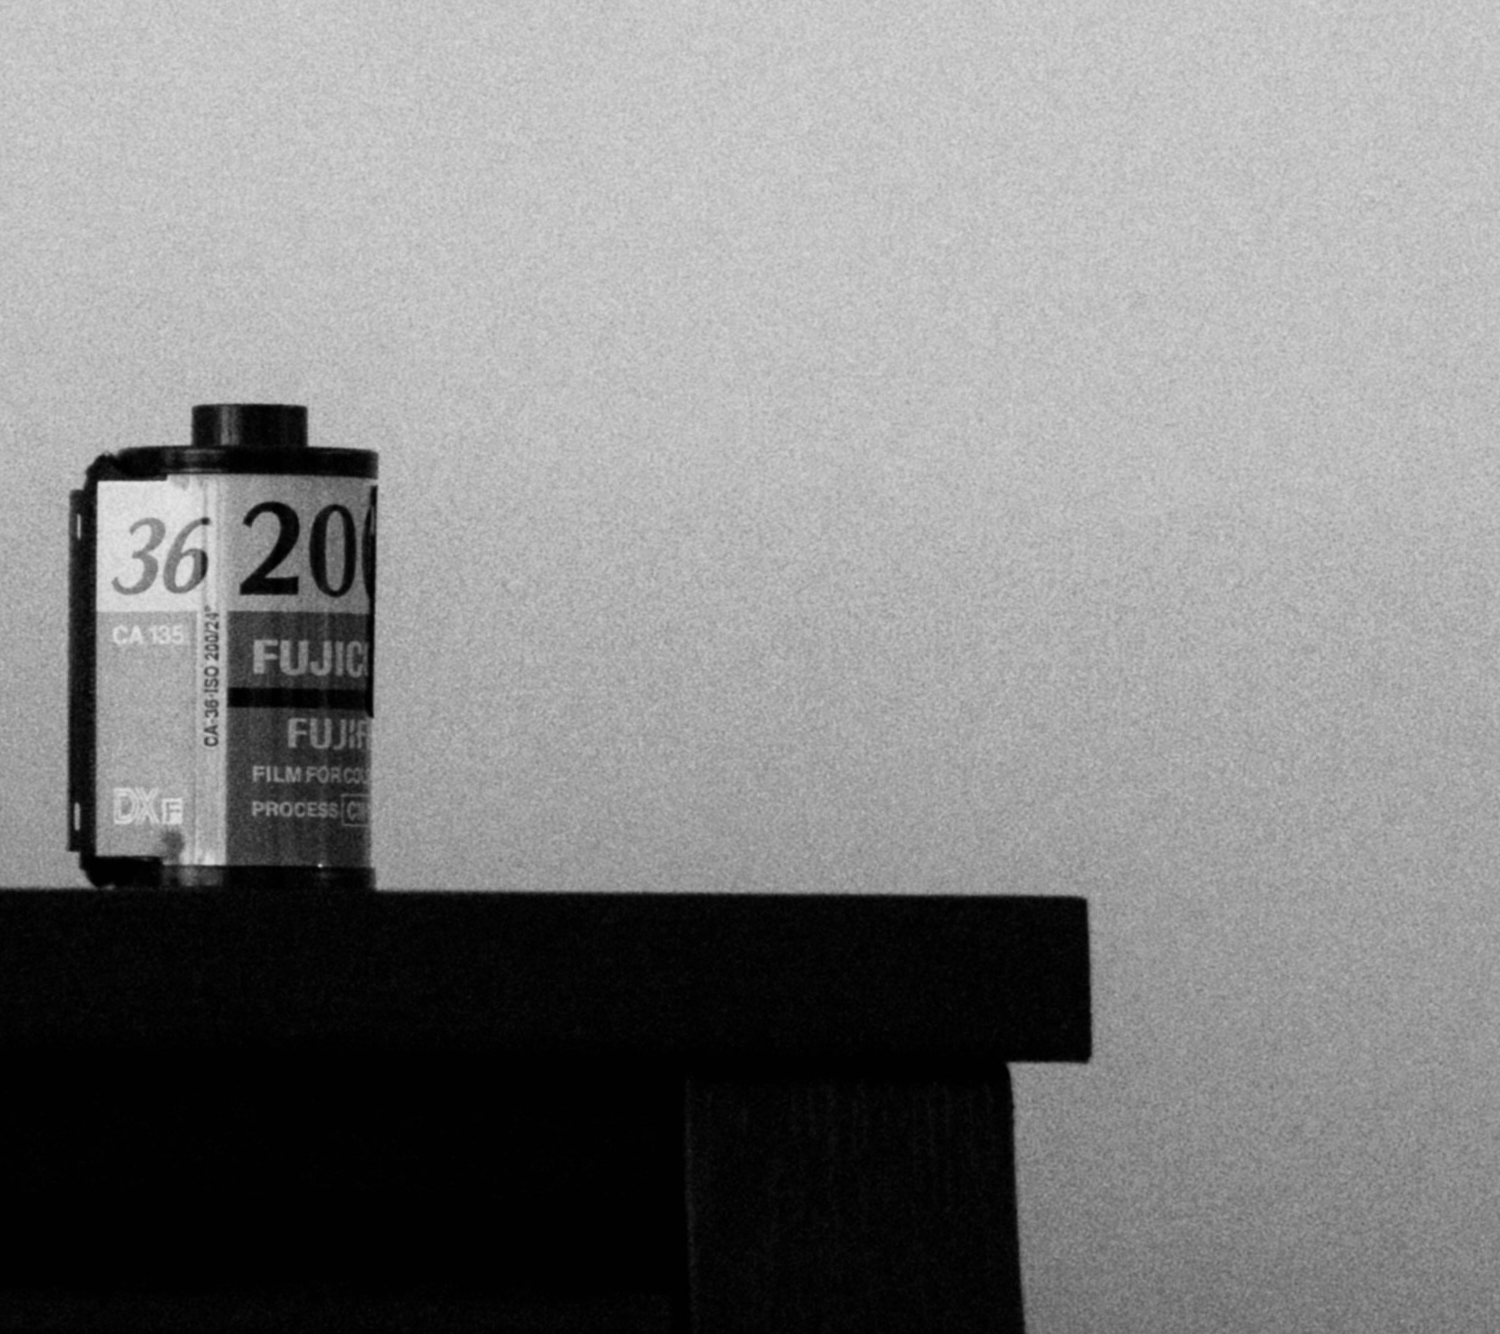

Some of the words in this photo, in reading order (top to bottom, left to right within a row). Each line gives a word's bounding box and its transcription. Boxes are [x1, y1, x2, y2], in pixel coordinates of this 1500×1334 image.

[110, 516, 212, 596] 36
[112, 624, 144, 646] CA
[149, 624, 185, 646] 135
[252, 765, 302, 784] FILM
[305, 765, 342, 784] FOR
[251, 800, 340, 820] PROCESS
